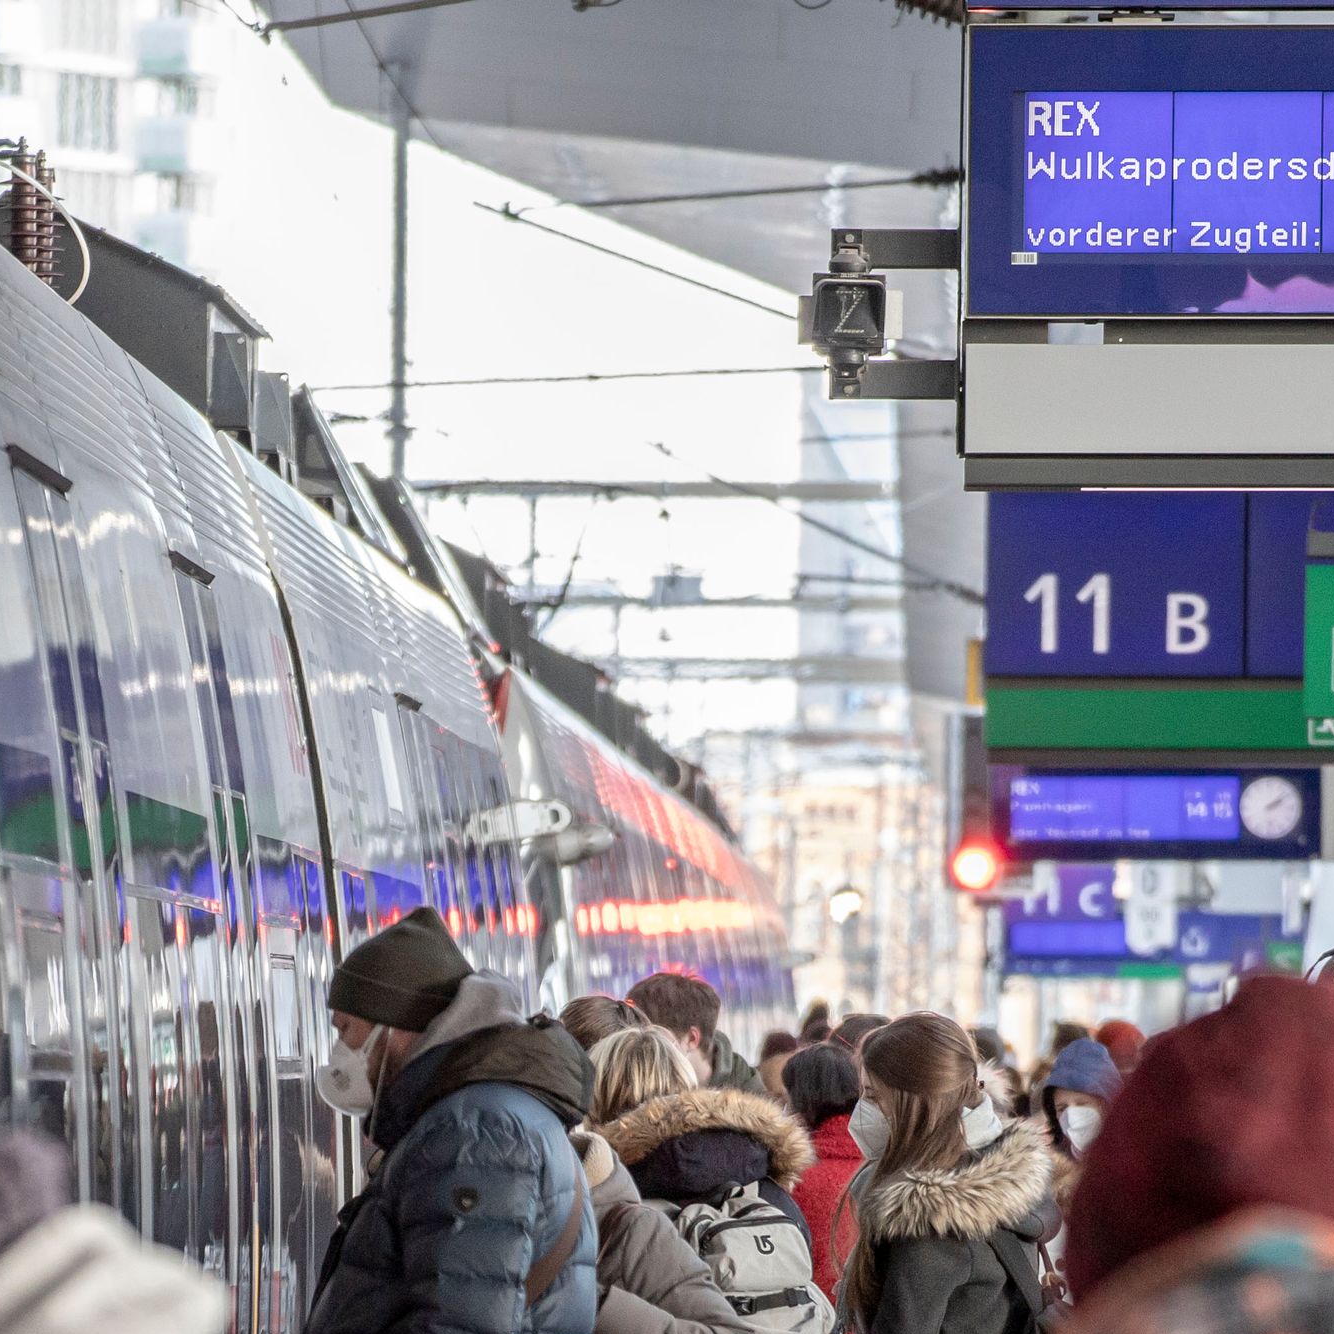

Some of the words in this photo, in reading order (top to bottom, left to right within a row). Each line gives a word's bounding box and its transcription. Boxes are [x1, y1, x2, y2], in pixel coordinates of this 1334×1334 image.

[1027, 100, 1100, 137] REX
[1027, 221, 1177, 248] vorderer
[1190, 221, 1321, 254] Zugteil:
[1023, 572, 1111, 654] 11
[1165, 592, 1210, 655] B
